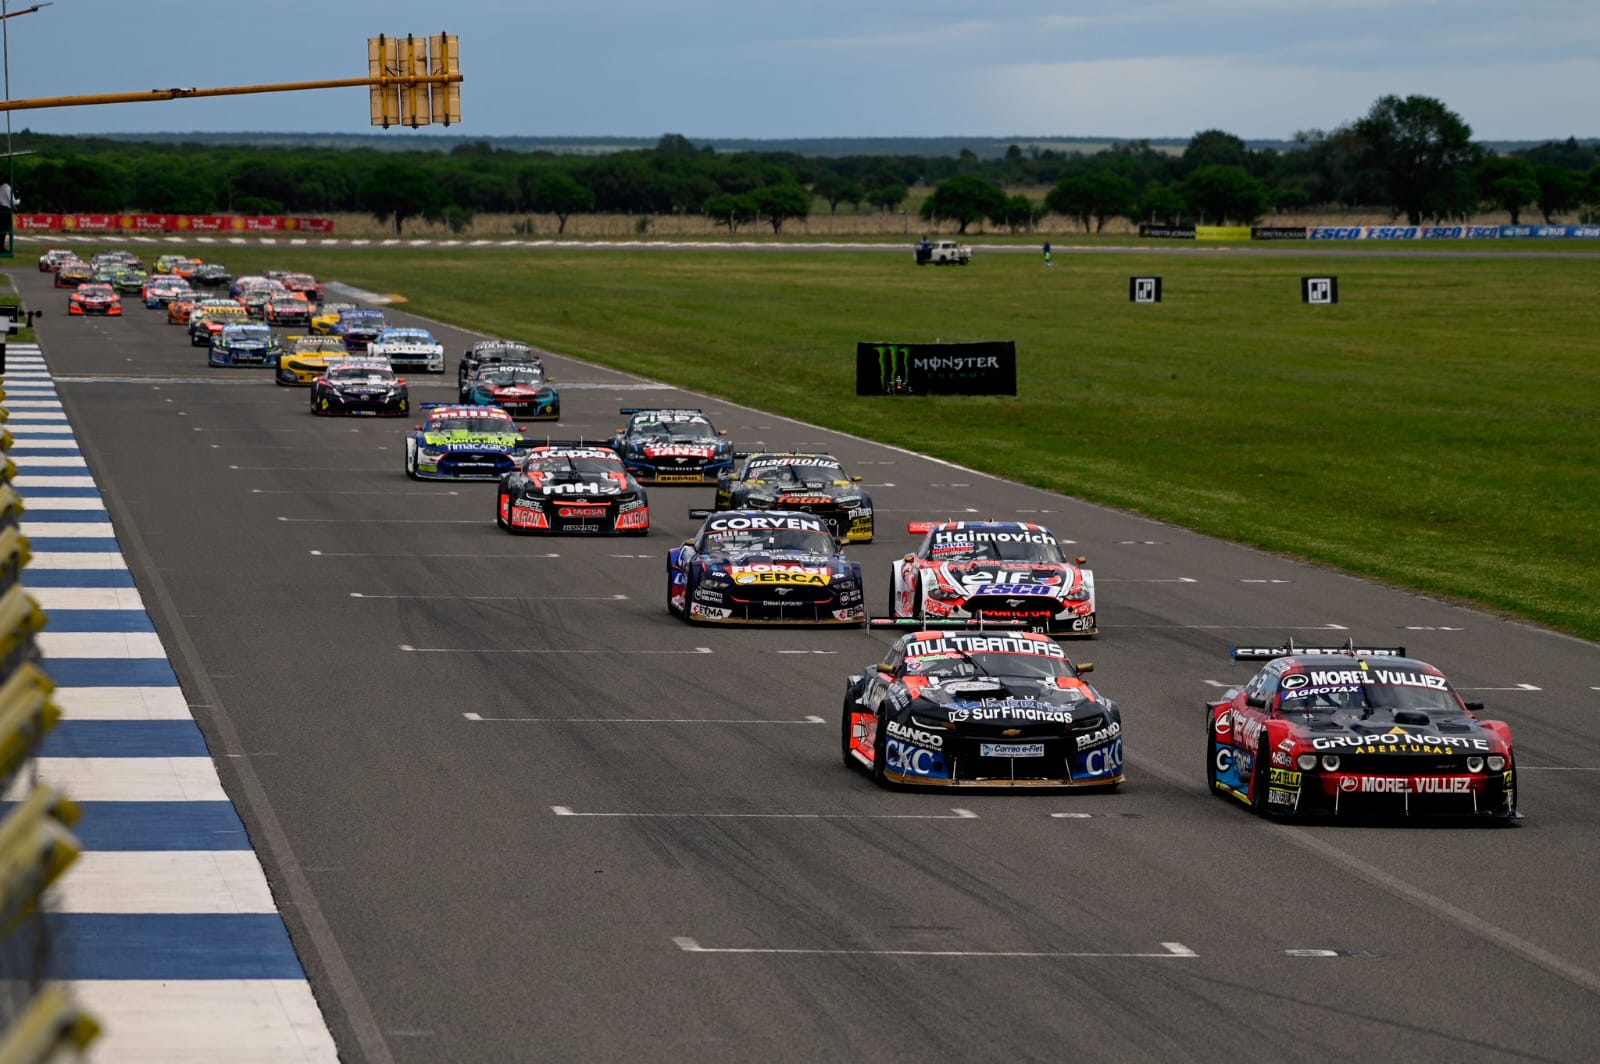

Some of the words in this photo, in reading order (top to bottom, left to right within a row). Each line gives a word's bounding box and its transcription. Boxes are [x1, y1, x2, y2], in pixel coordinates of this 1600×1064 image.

[1309, 227, 1361, 239] ESCO
[1367, 227, 1418, 239] ESCO
[1422, 227, 1467, 238] ESCO
[1466, 226, 1498, 238] ESCO
[914, 356, 999, 370] MONSTER
[711, 518, 820, 531] CORVEN
[936, 530, 1057, 545] Haimovich
[962, 570, 1031, 584] elf
[976, 584, 1051, 595] ESCO
[907, 637, 1066, 658] MULTIBANDAS
[1310, 671, 1375, 686] MOREL
[1375, 670, 1448, 691] VULLIEZ
[1285, 686, 1359, 700] AGROTAX
[972, 707, 1073, 723] SurFinanzas
[887, 720, 944, 747] BLANCO
[994, 745, 1021, 753] Correo
[1312, 734, 1399, 750] GRUPO
[1405, 734, 1490, 751] NORTE
[1355, 744, 1453, 755] ABERTURAS
[885, 739, 935, 775] CKC
[1362, 777, 1412, 793] MOREL
[1415, 777, 1471, 793] VULLIEZ
